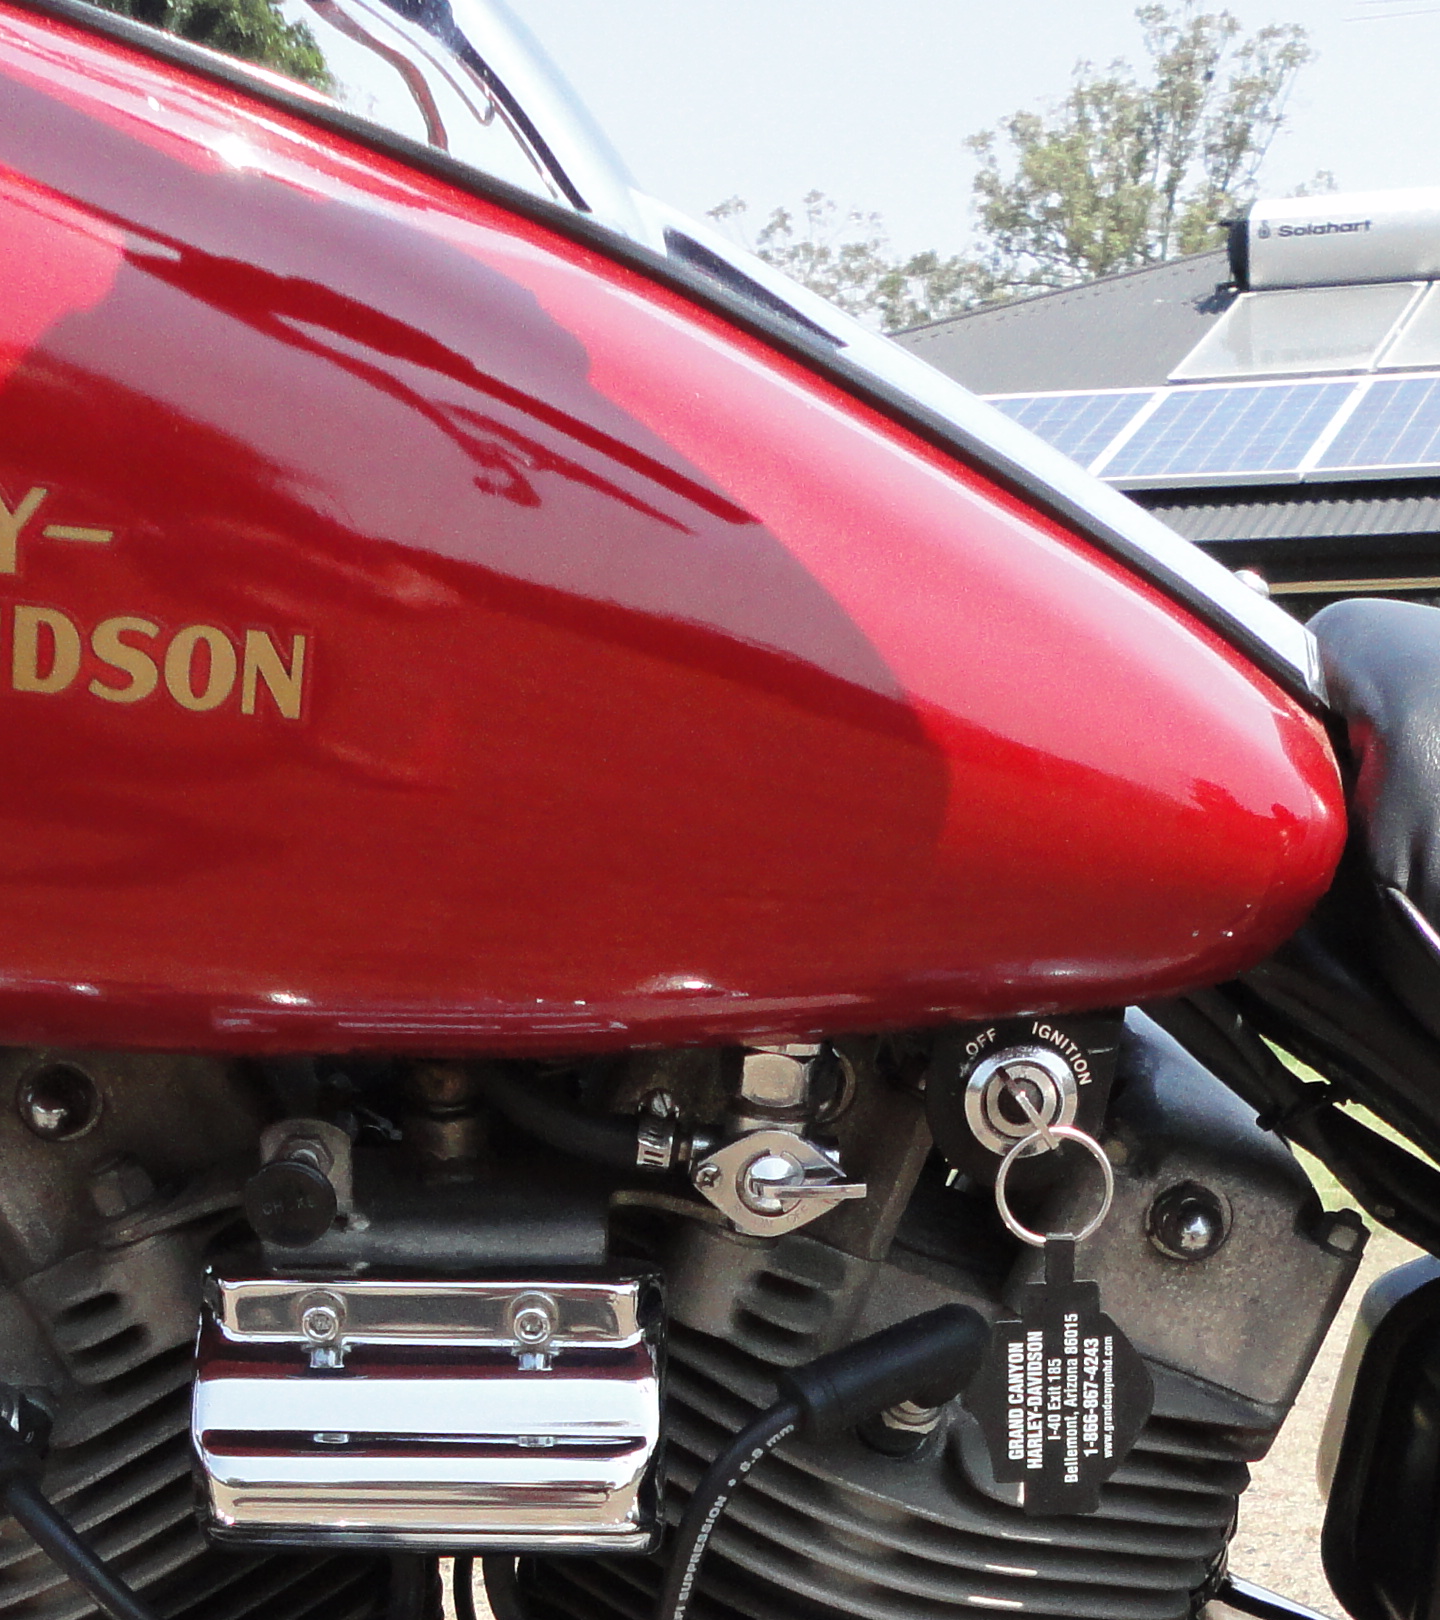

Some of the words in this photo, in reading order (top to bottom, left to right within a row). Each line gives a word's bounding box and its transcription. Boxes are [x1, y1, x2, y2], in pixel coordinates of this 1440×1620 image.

[1278, 219, 1372, 238] Solahart
[965, 1027, 997, 1056] OFF
[1031, 1021, 1093, 1086] IGNITION
[1063, 1313, 1078, 1355] 86015
[1007, 1342, 1025, 1405] CANYON
[1047, 1357, 1062, 1383] 185
[1063, 1357, 1078, 1408] Arizona
[1102, 1335, 1116, 1459] www.grandcanyonhd.com
[1026, 1330, 1044, 1470] HARLEY-DAVIDSON
[1047, 1385, 1062, 1411] Exit
[1082, 1337, 1099, 1458] 1-866-867-4243
[1007, 1407, 1025, 1461] GRAND
[1047, 1413, 1062, 1441] I-40
[1063, 1411, 1080, 1483] Bellemont,
[678, 1495, 728, 1601] SUPPRESSION
[765, 1424, 795, 1448] mm
